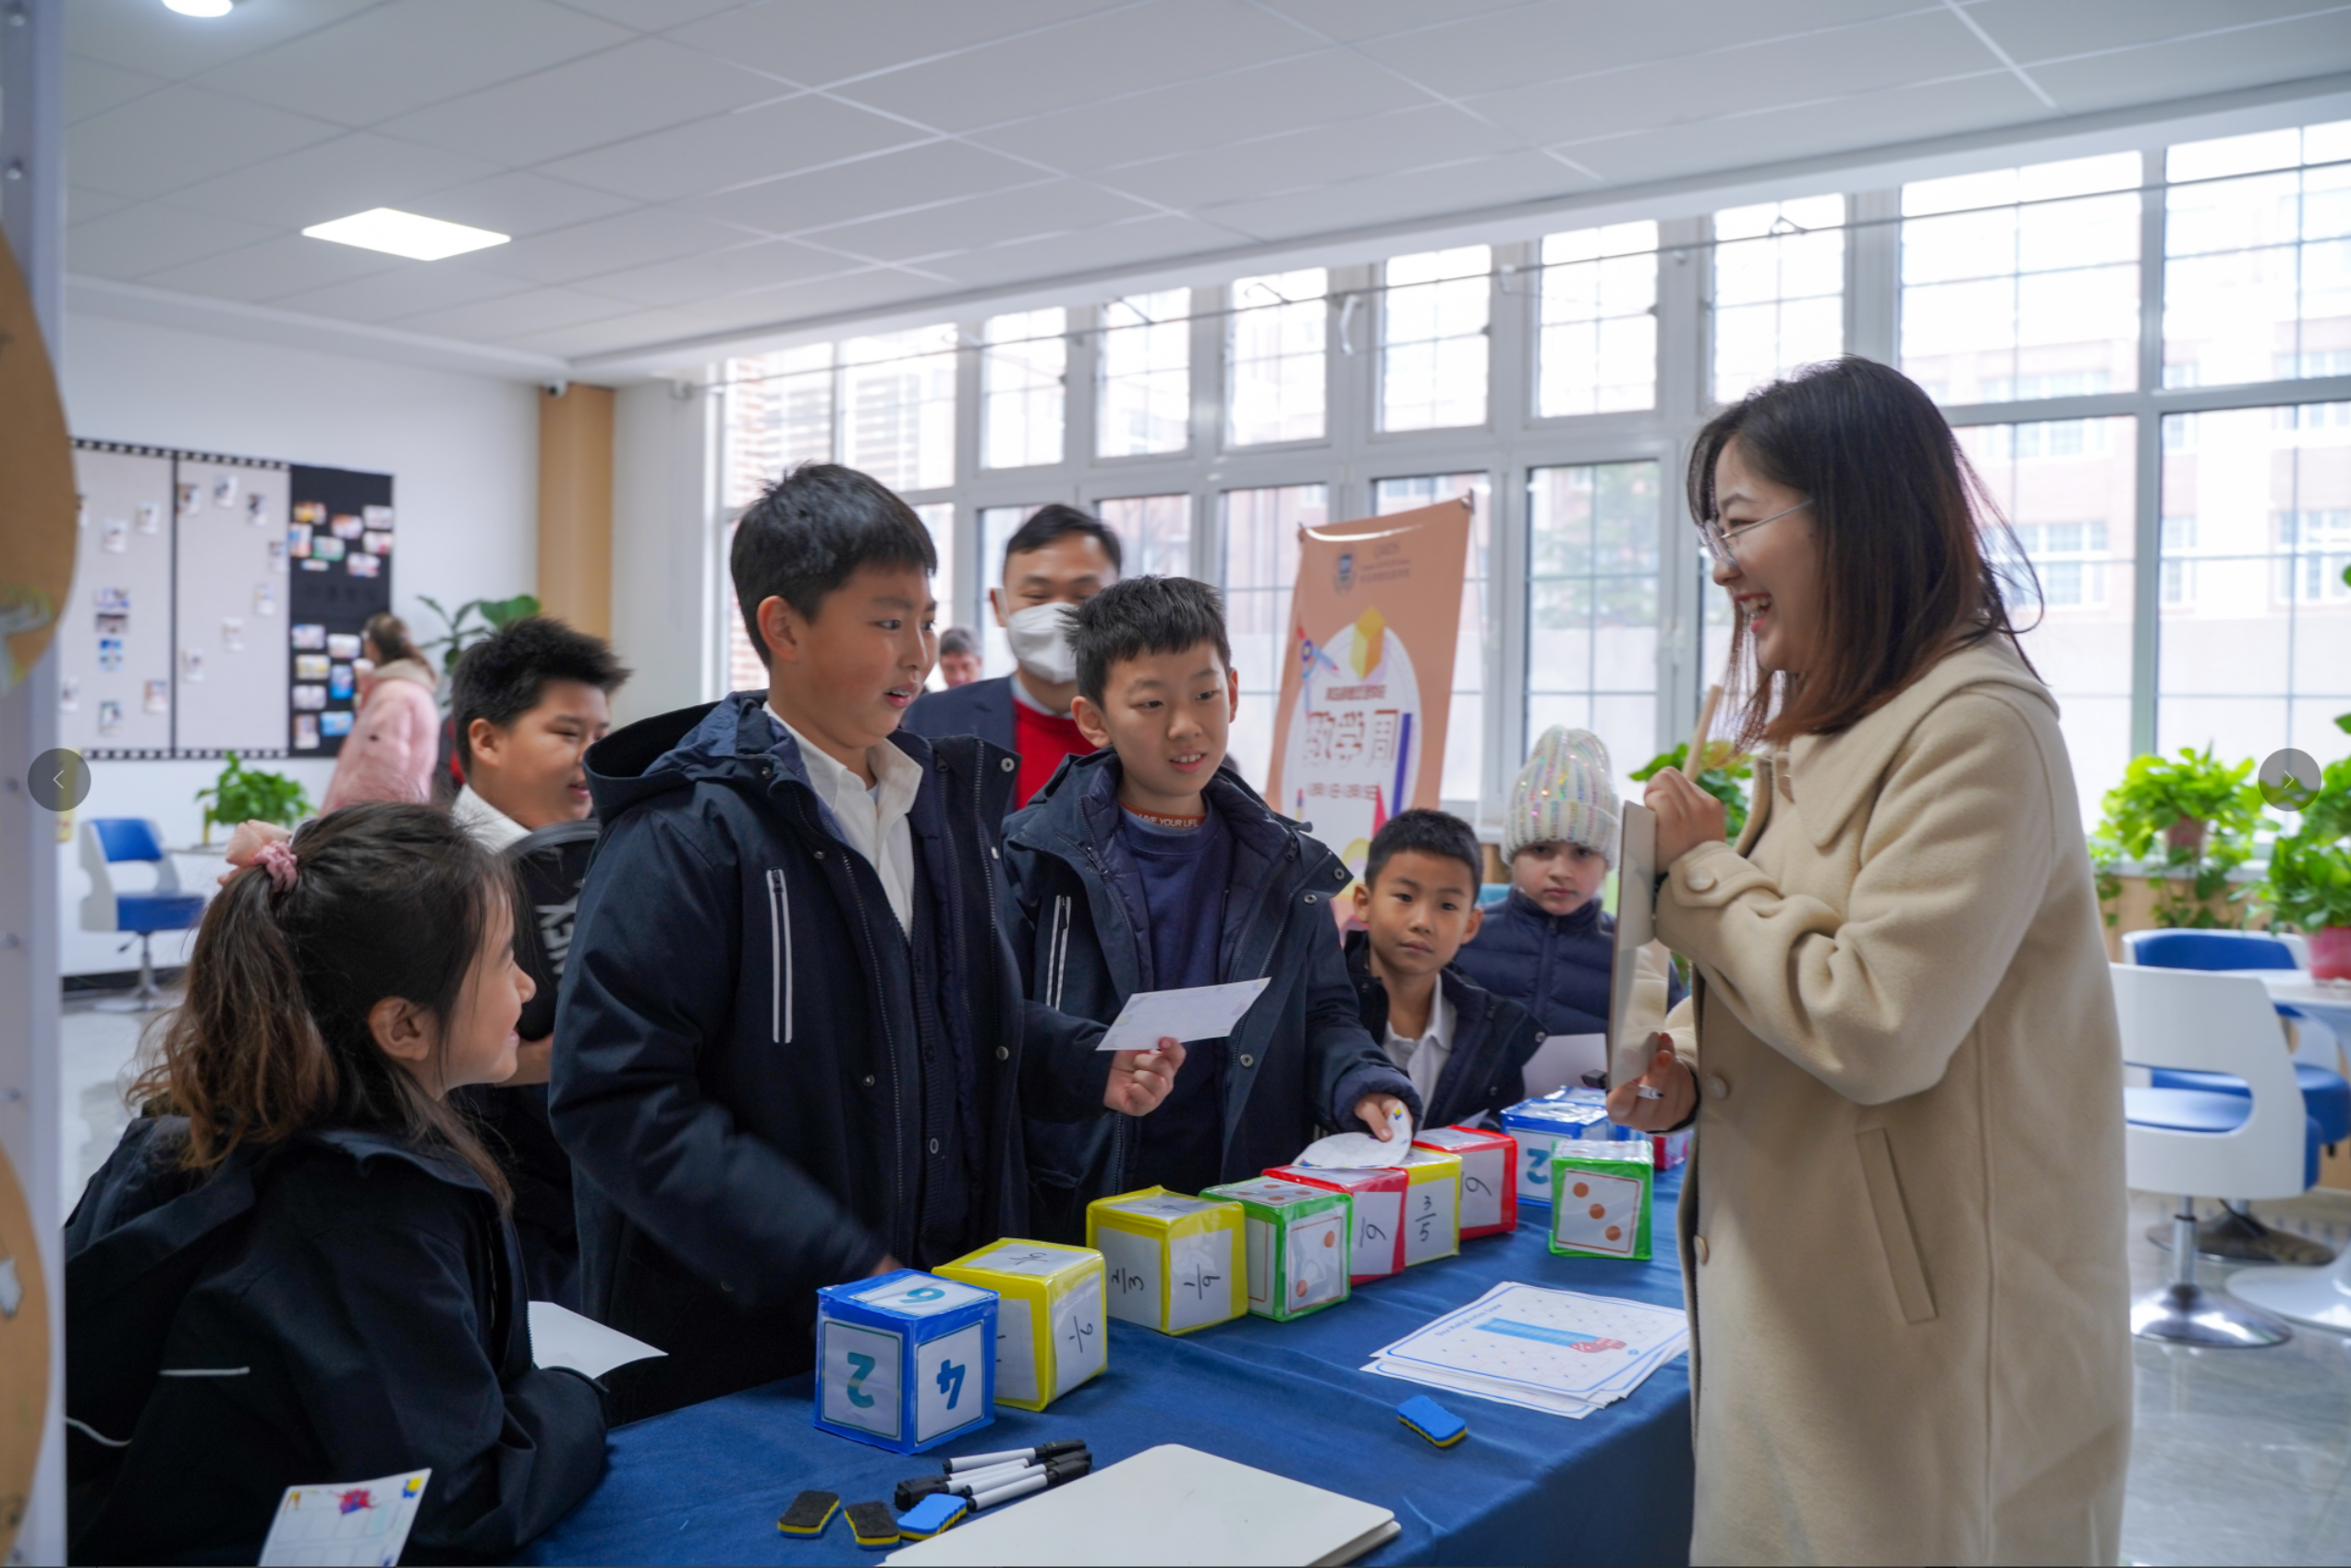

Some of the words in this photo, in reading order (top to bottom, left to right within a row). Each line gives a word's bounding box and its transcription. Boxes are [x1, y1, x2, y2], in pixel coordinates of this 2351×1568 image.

[1159, 817, 1182, 827] YOUR
[1184, 819, 1199, 827] LIFE
[847, 1351, 876, 1409] 2
[936, 1358, 966, 1410] 4
